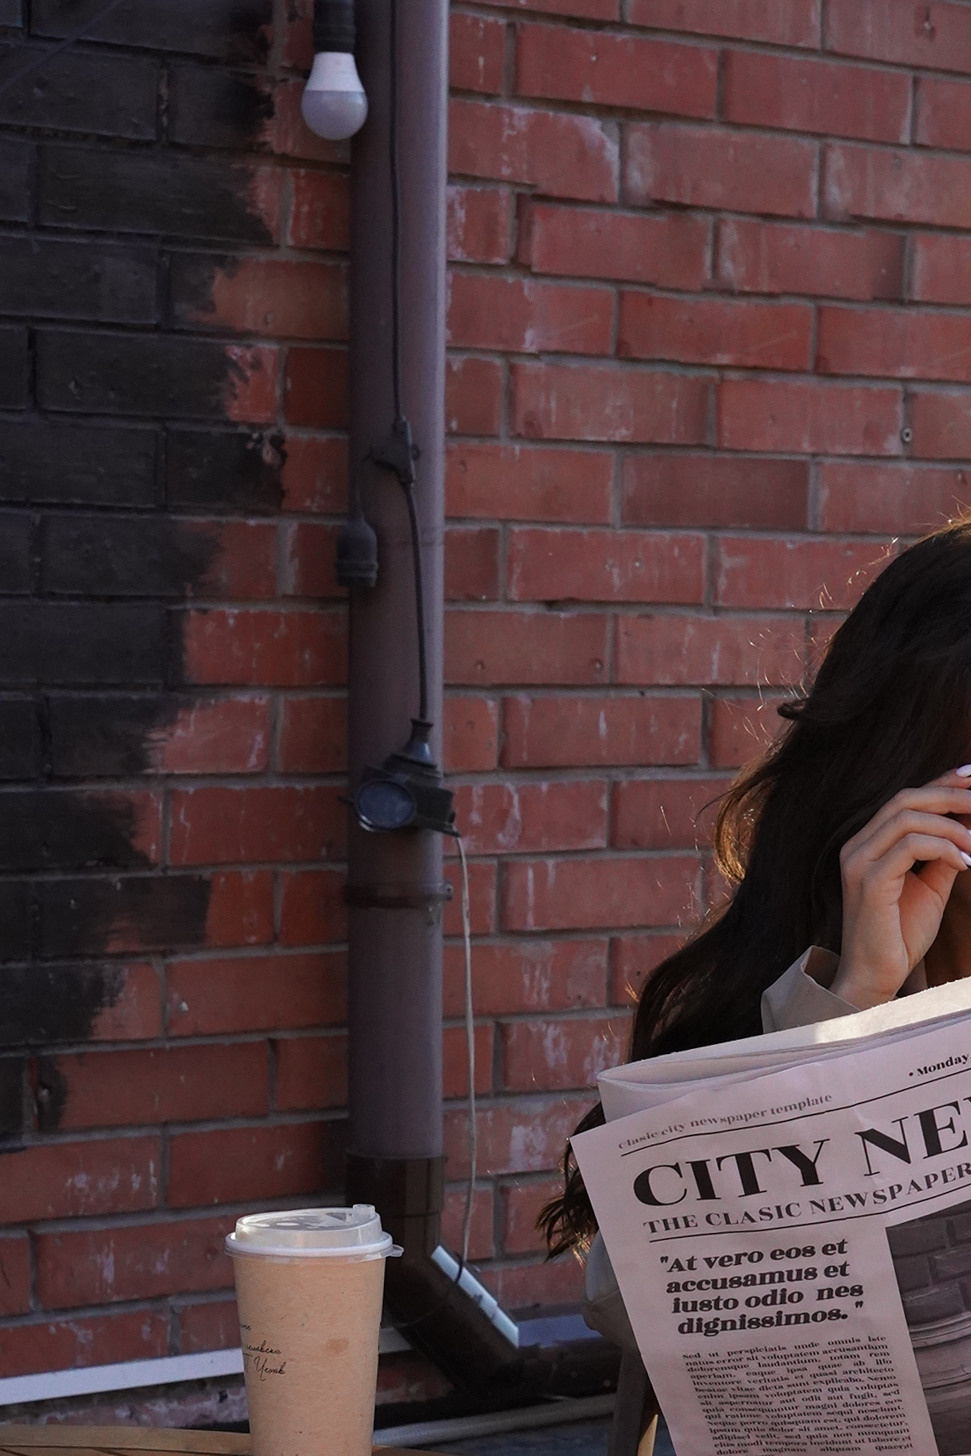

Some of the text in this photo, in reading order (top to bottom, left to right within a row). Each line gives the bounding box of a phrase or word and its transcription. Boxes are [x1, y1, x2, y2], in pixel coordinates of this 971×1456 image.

[660, 1121, 686, 1137] city
[690, 1108, 768, 1128] newspaper
[770, 1093, 832, 1116] template
[632, 1138, 831, 1208] CITY
[643, 1213, 698, 1236] THE
[704, 1201, 802, 1228] CLASIC
[660, 1238, 849, 1273] "At vero eos et
[666, 1260, 850, 1294] accusamus et
[672, 1284, 864, 1314] iusto odio nes
